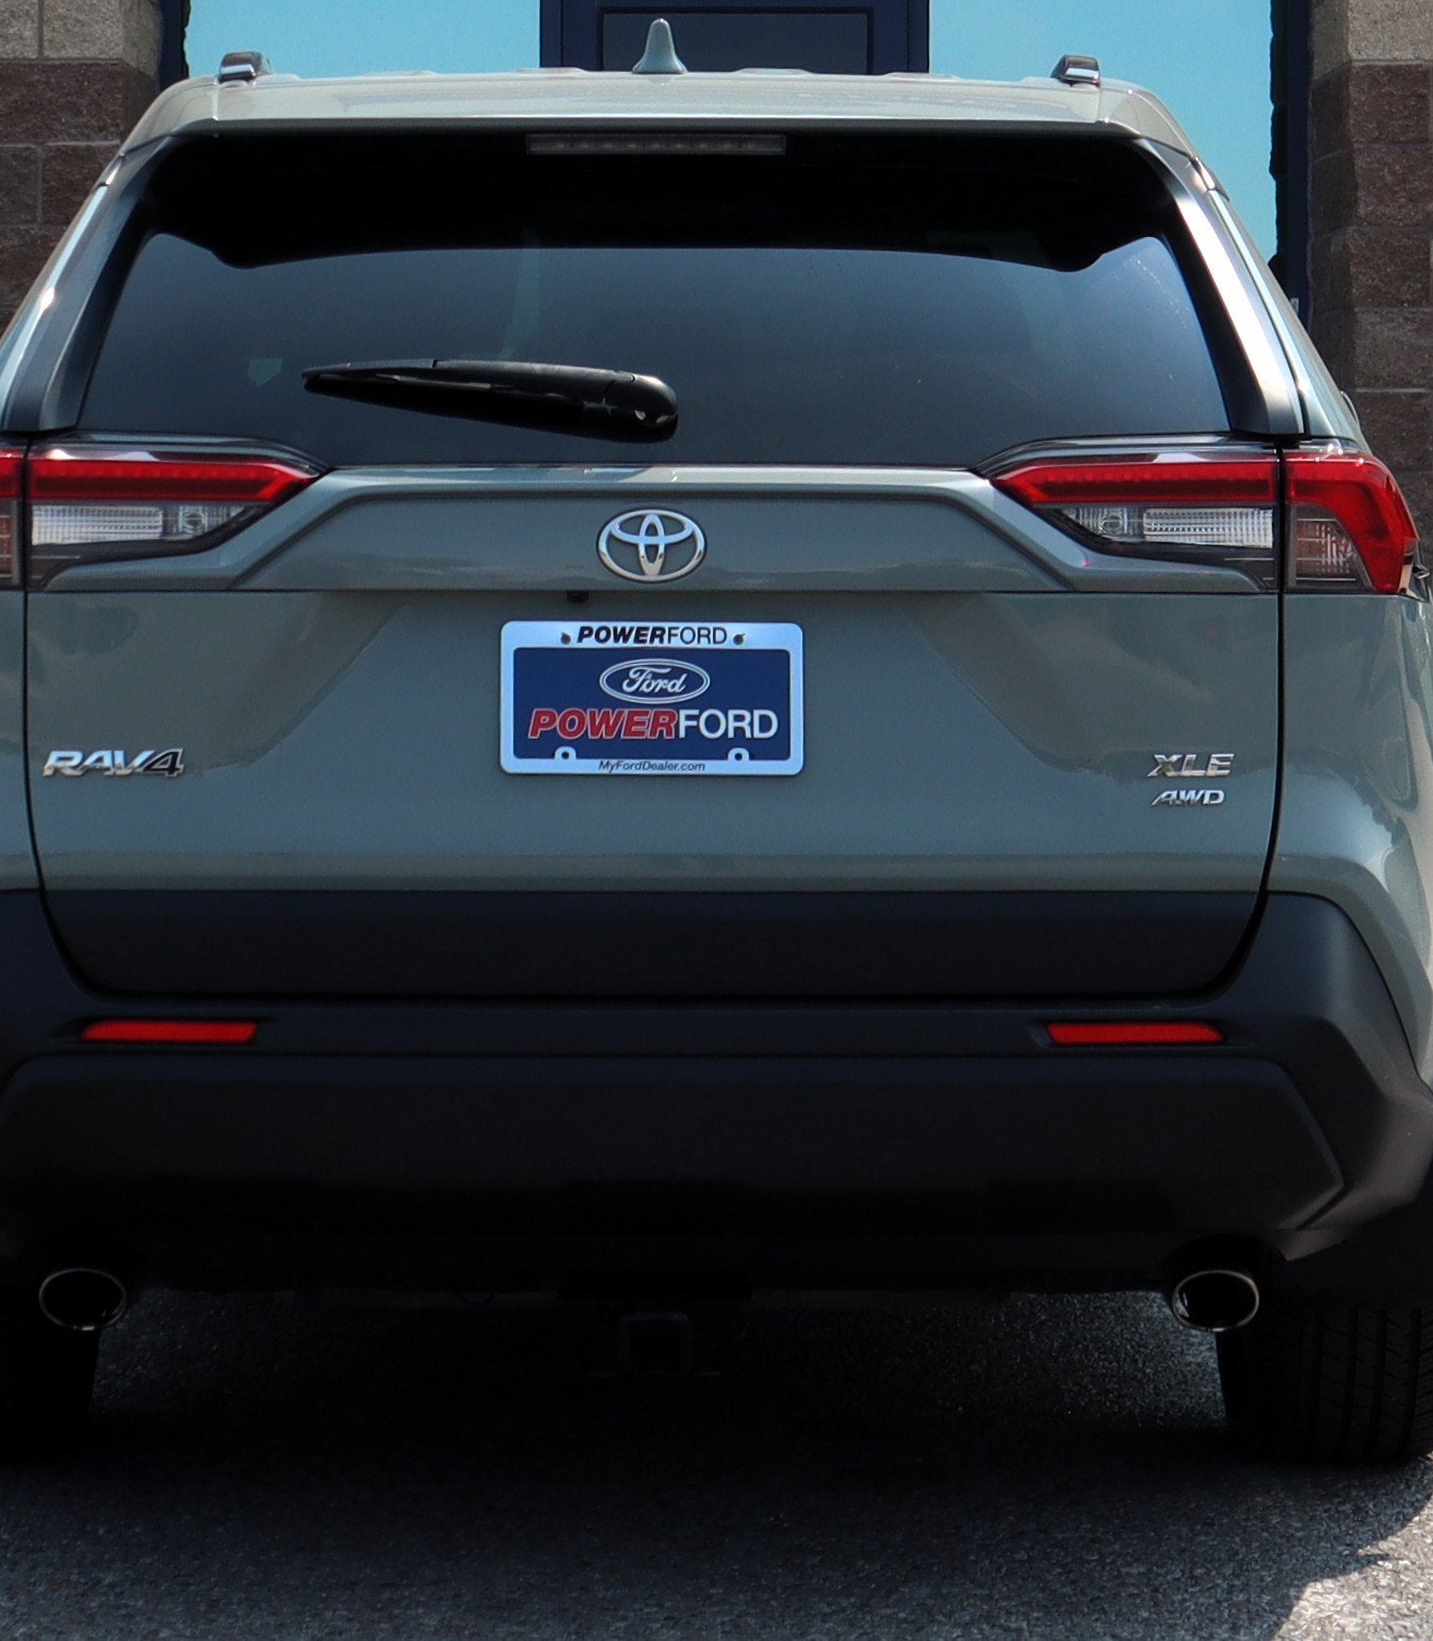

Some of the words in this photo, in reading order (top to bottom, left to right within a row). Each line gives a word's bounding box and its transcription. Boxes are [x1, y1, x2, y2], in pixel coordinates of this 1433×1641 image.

[622, 666, 688, 693] Ford
[527, 707, 779, 739] POWERFORD
[42, 748, 185, 778] RAV4
[598, 760, 706, 773] MyFordDealer.com
[1146, 753, 1235, 778] XLE
[1151, 789, 1225, 806] AWD
